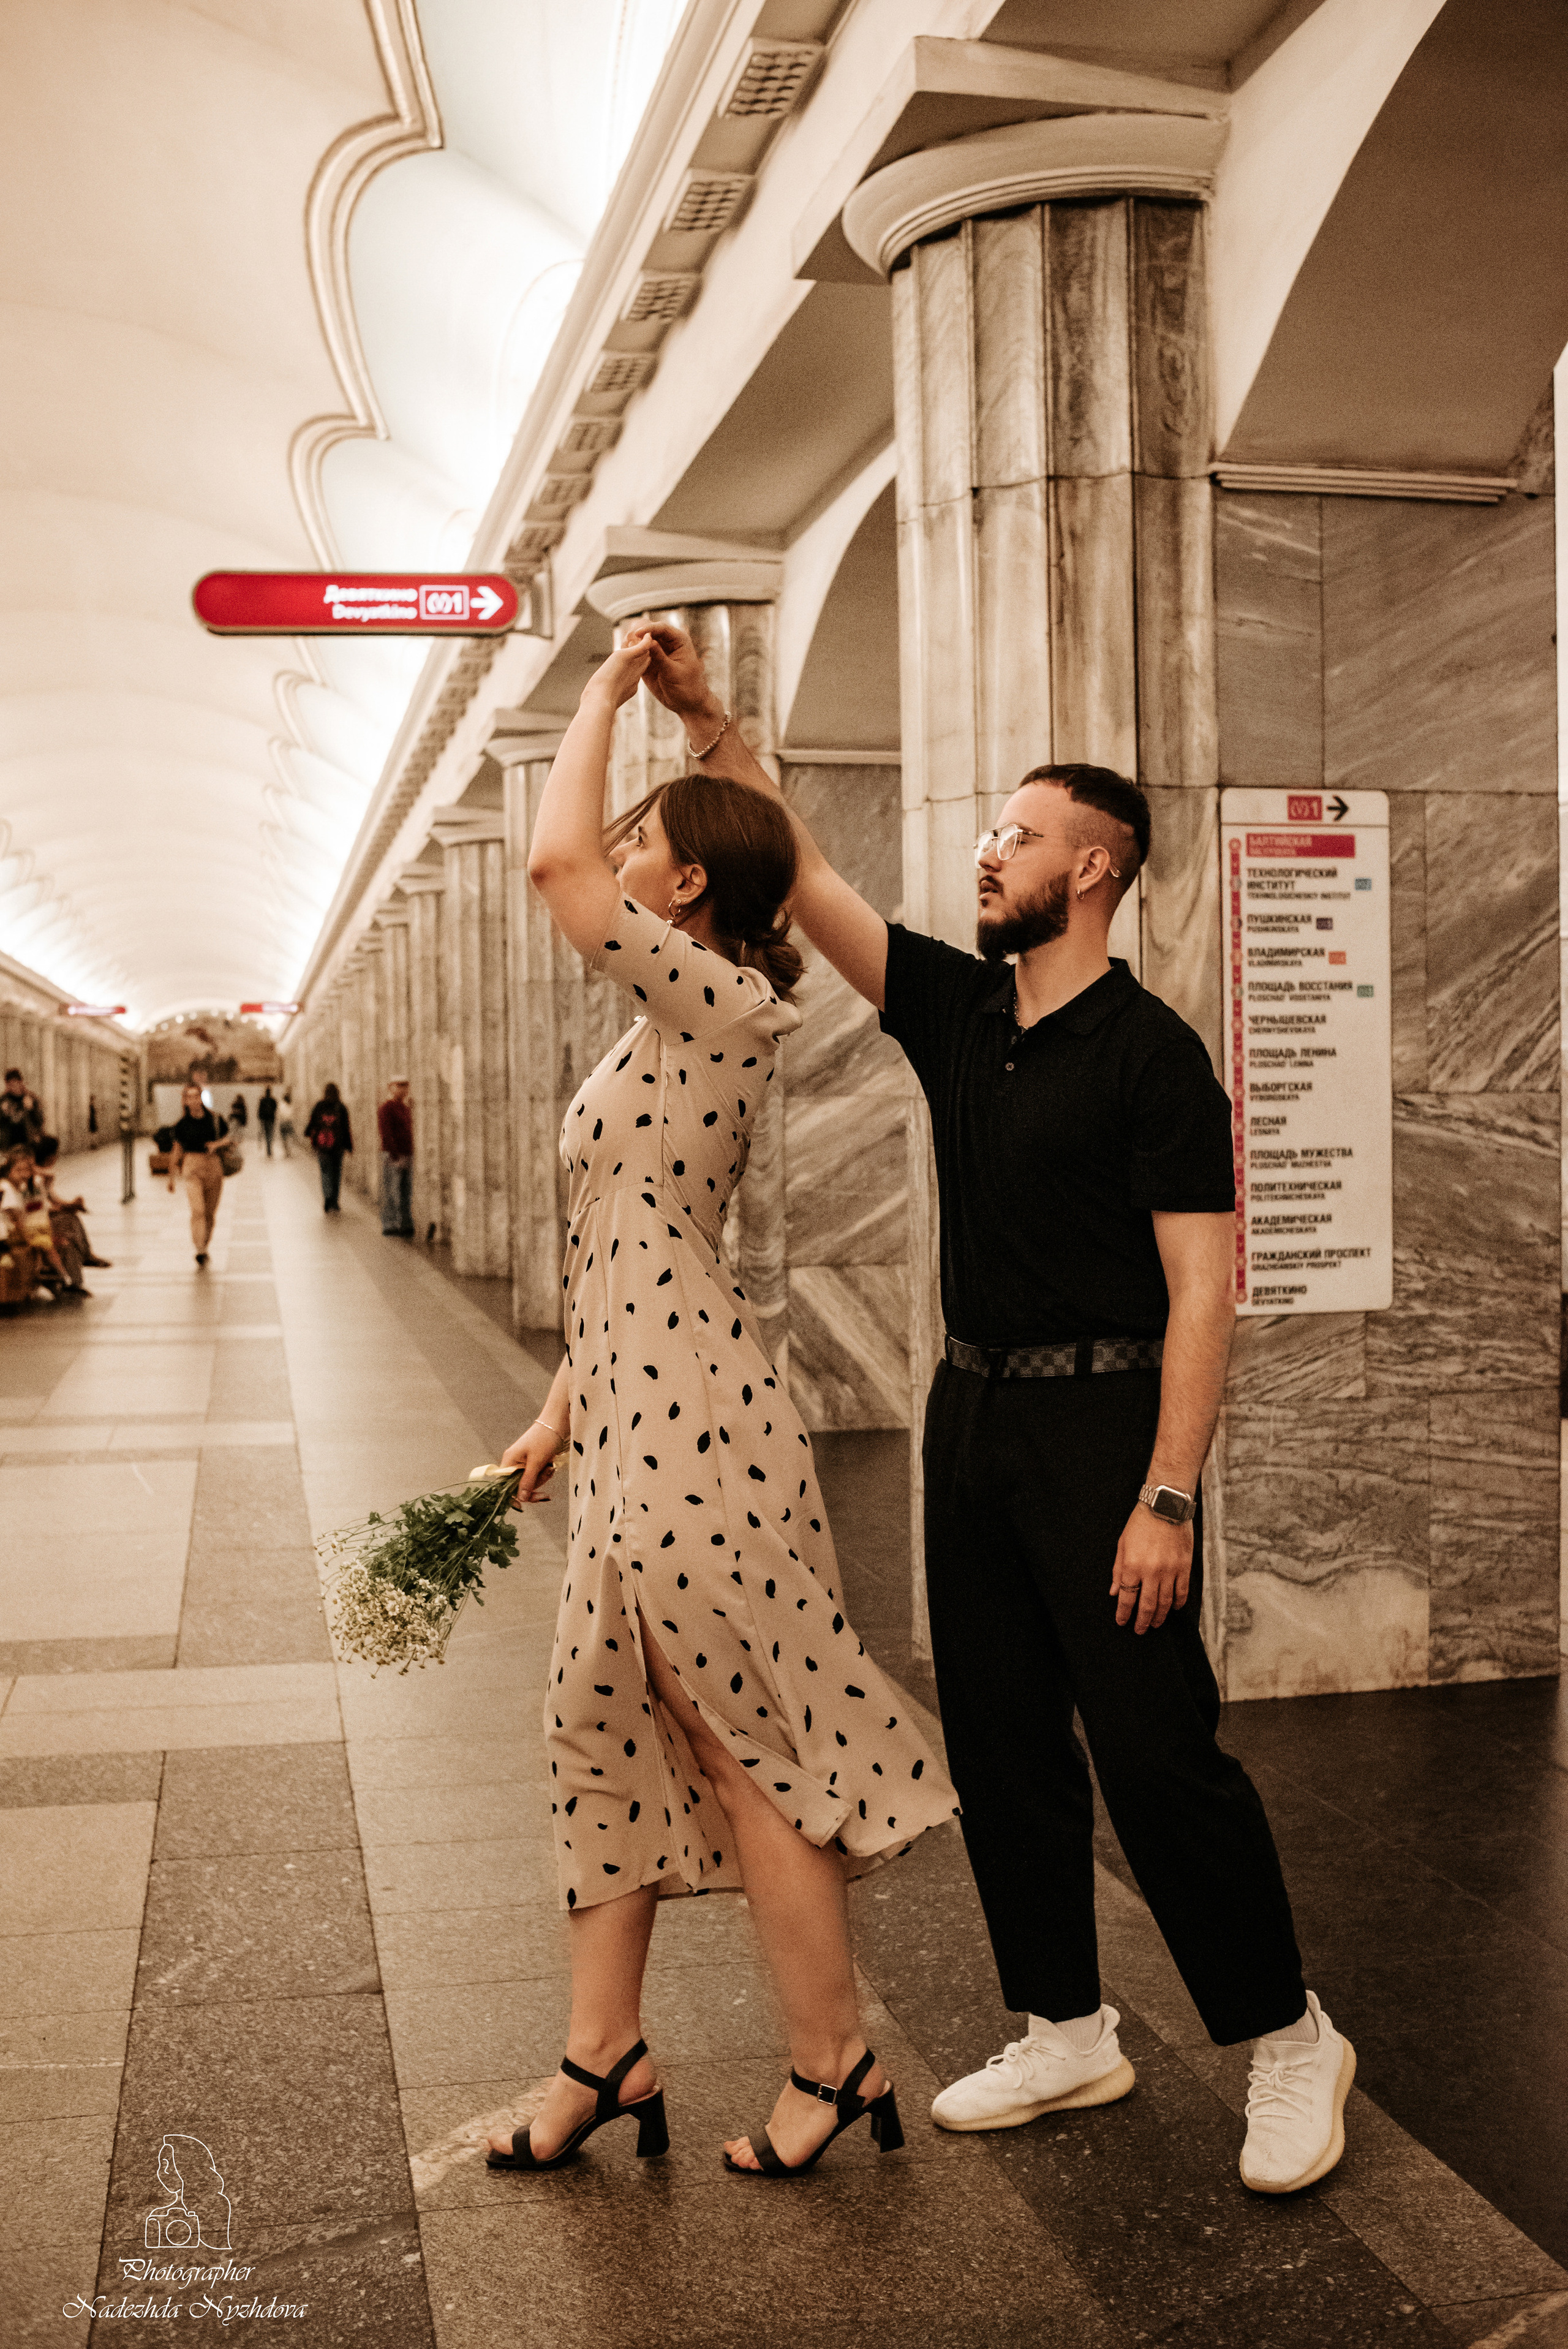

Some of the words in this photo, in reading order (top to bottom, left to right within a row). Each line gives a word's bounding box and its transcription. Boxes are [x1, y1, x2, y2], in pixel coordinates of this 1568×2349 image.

[1247, 867, 1338, 877] ТЕХНОЛОГИЧЕСКИЙ
[1247, 880, 1295, 890] ИНСТИТУТ
[1247, 914, 1312, 923] ПУШКИНСКАЯ
[1248, 947, 1325, 958] ВЛАДИМИРСКАЯ
[1248, 982, 1295, 992] ПЛОЩАДЬ
[1298, 982, 1352, 991] ВОССТАНИЯ
[1248, 1015, 1327, 1024] ЧЕРНЫШЕВСКАЯ
[1249, 1048, 1297, 1059] ПЛОЩАДЬ
[1300, 1047, 1336, 1057] ЛЕНИНА
[1250, 1082, 1313, 1092] ВЫБОРГСКАЯ
[1251, 1116, 1287, 1126] ЛЕСНАЯ
[1250, 1149, 1298, 1160] ПЛОЩАДЬ
[1301, 1148, 1353, 1158] МУЖЕСТВА
[1251, 1181, 1342, 1192] ПОЛИТЕХНИЧЕСКАЯ
[1251, 1214, 1332, 1225] АКАДЕМИЧЕСКАЯ
[1251, 1249, 1321, 1261] ГРАЖДАНСКИЙ
[1324, 1247, 1371, 1258] ПРОСПЕКТ
[1252, 1285, 1307, 1297] ДЕВЯТКИНО
